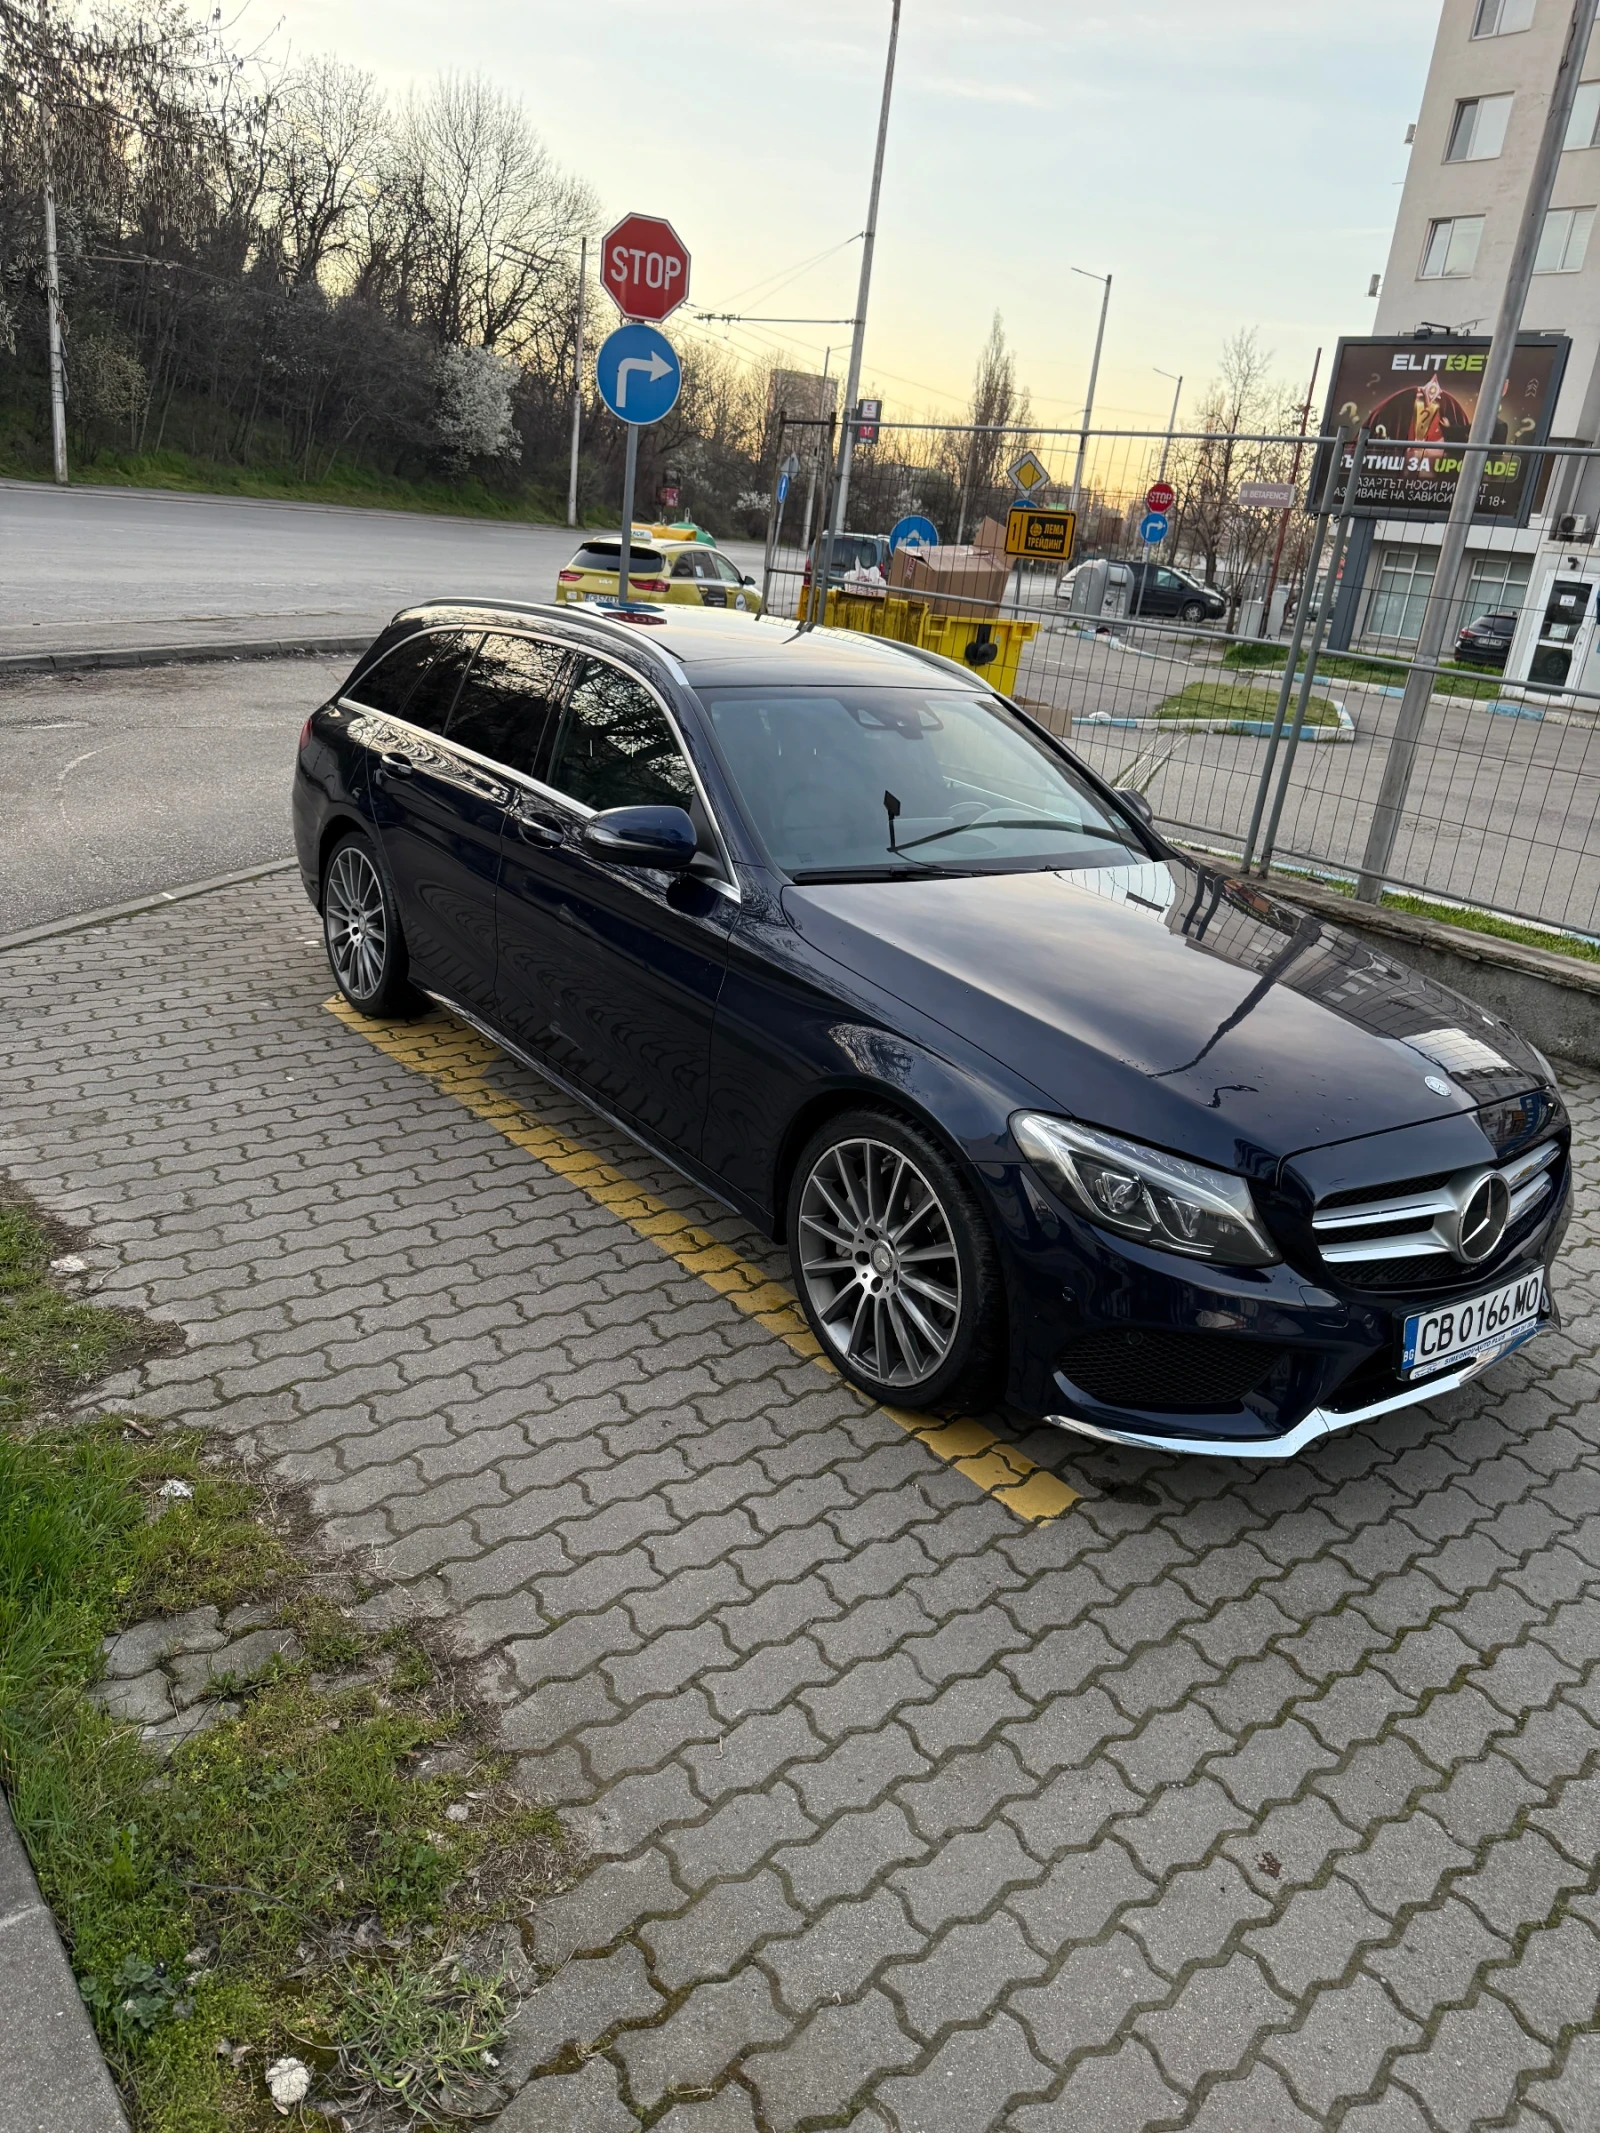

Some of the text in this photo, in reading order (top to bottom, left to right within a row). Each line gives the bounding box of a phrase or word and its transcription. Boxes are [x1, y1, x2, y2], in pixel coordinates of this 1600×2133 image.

[610, 245, 682, 290] STOP
[1391, 354, 1489, 371] ELITBE
[1340, 454, 1518, 477] ЪТИШ ЗА UPADE
[1405, 479, 1438, 491] НОСИ
[1148, 491, 1172, 504] STOP
[1249, 490, 1289, 500] BETAFENCE
[1390, 490, 1405, 500] НА
[1408, 490, 1486, 506] ЗАВИСИТ
[1489, 495, 1507, 507] 18+
[1043, 523, 1064, 535] ЛЕМА
[1028, 535, 1063, 550] ТРЕЙДИНГ
[1403, 1348, 1415, 1362] BG
